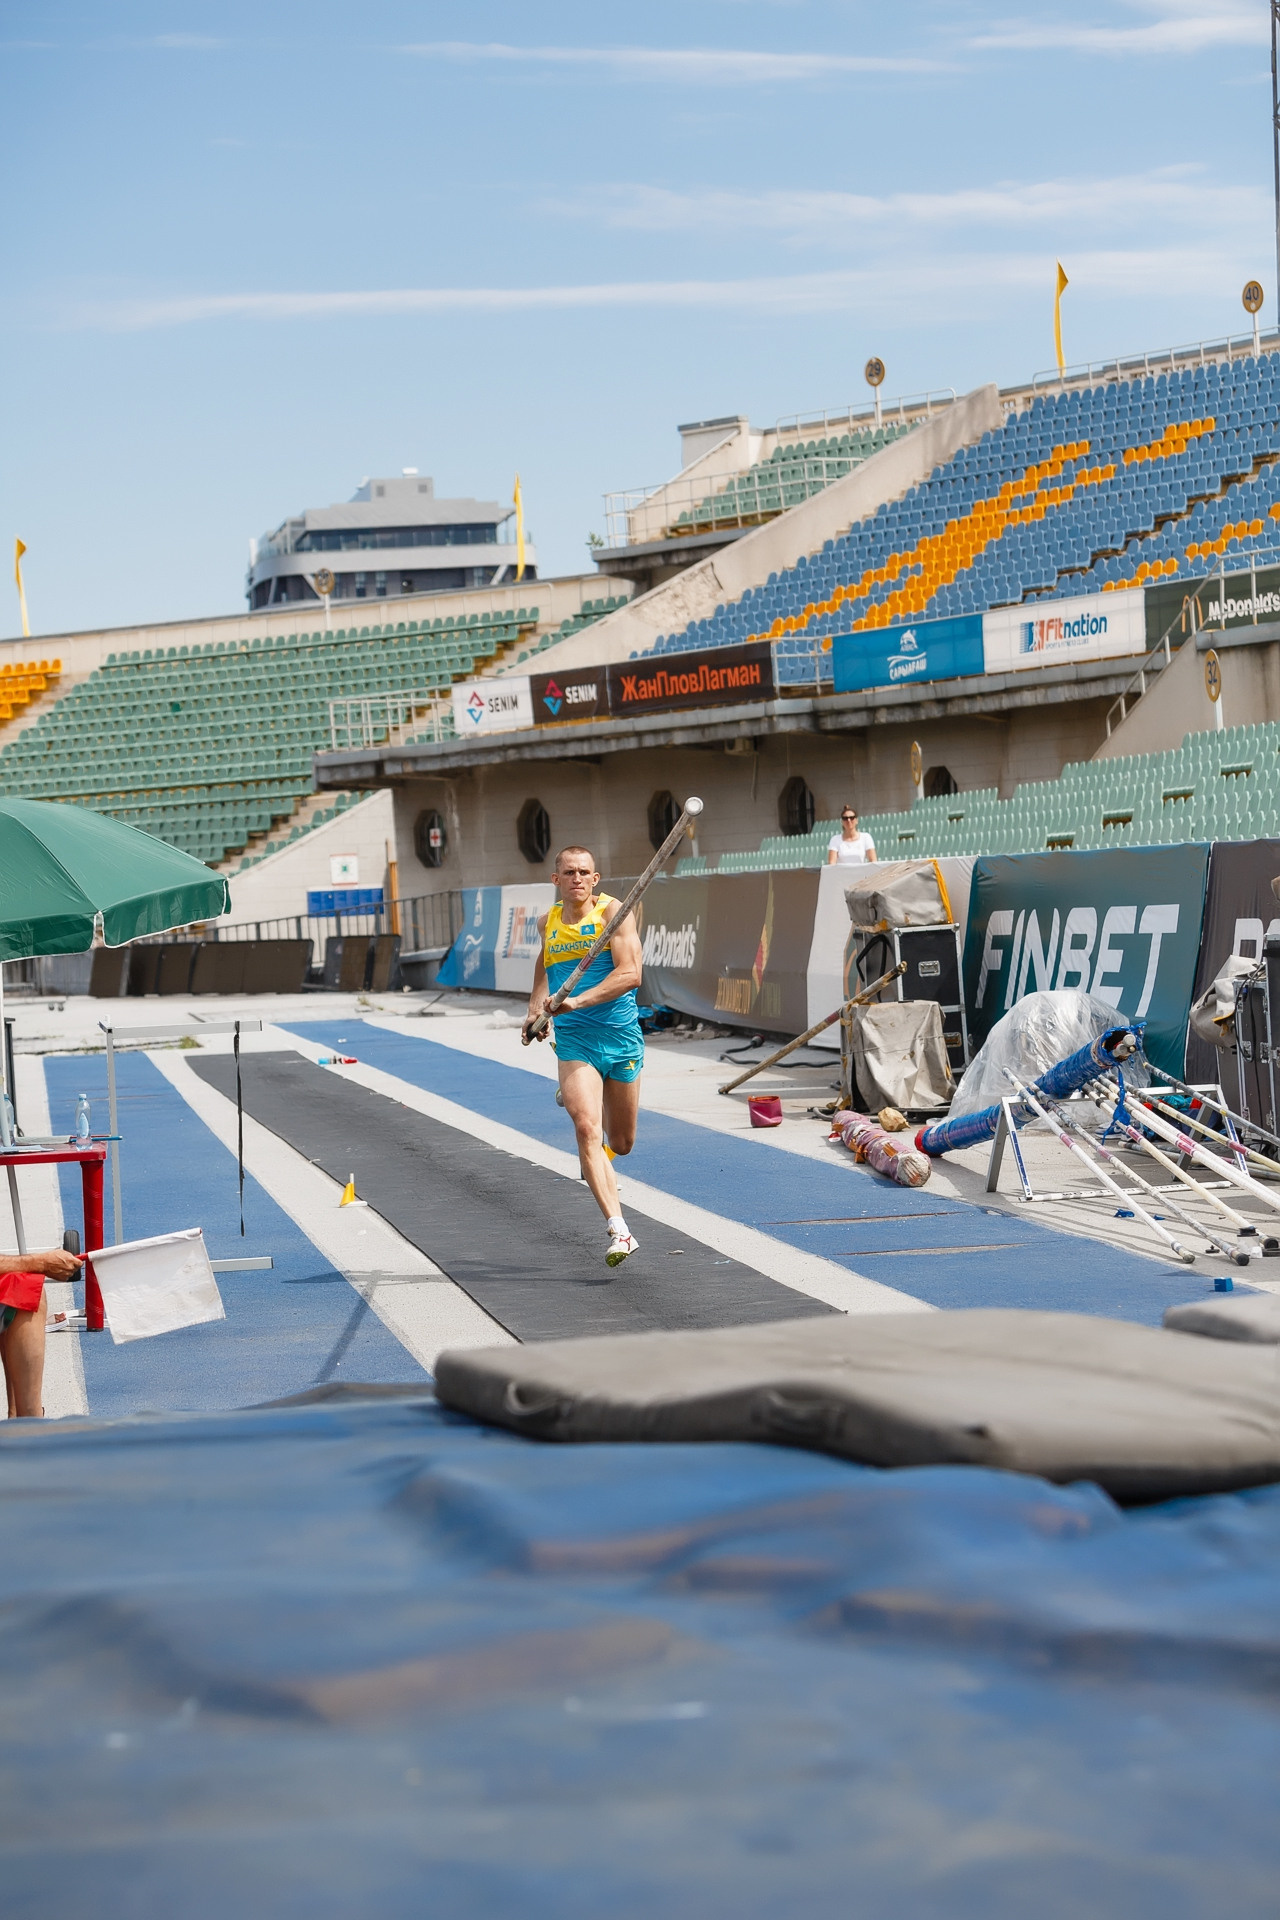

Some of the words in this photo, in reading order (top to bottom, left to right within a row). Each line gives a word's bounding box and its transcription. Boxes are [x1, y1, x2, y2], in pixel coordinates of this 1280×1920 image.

[1245, 286, 1260, 301] 40
[1046, 613, 1107, 641] Fitnation
[620, 663, 761, 702] ЖанПловЛагман
[1207, 660, 1218, 684] 32
[488, 694, 519, 713] SENIM
[564, 683, 598, 704] SENIM
[548, 939, 597, 954] AZAKHSTAN
[642, 924, 697, 969] McDonald's
[975, 904, 1180, 1018] FINBET
